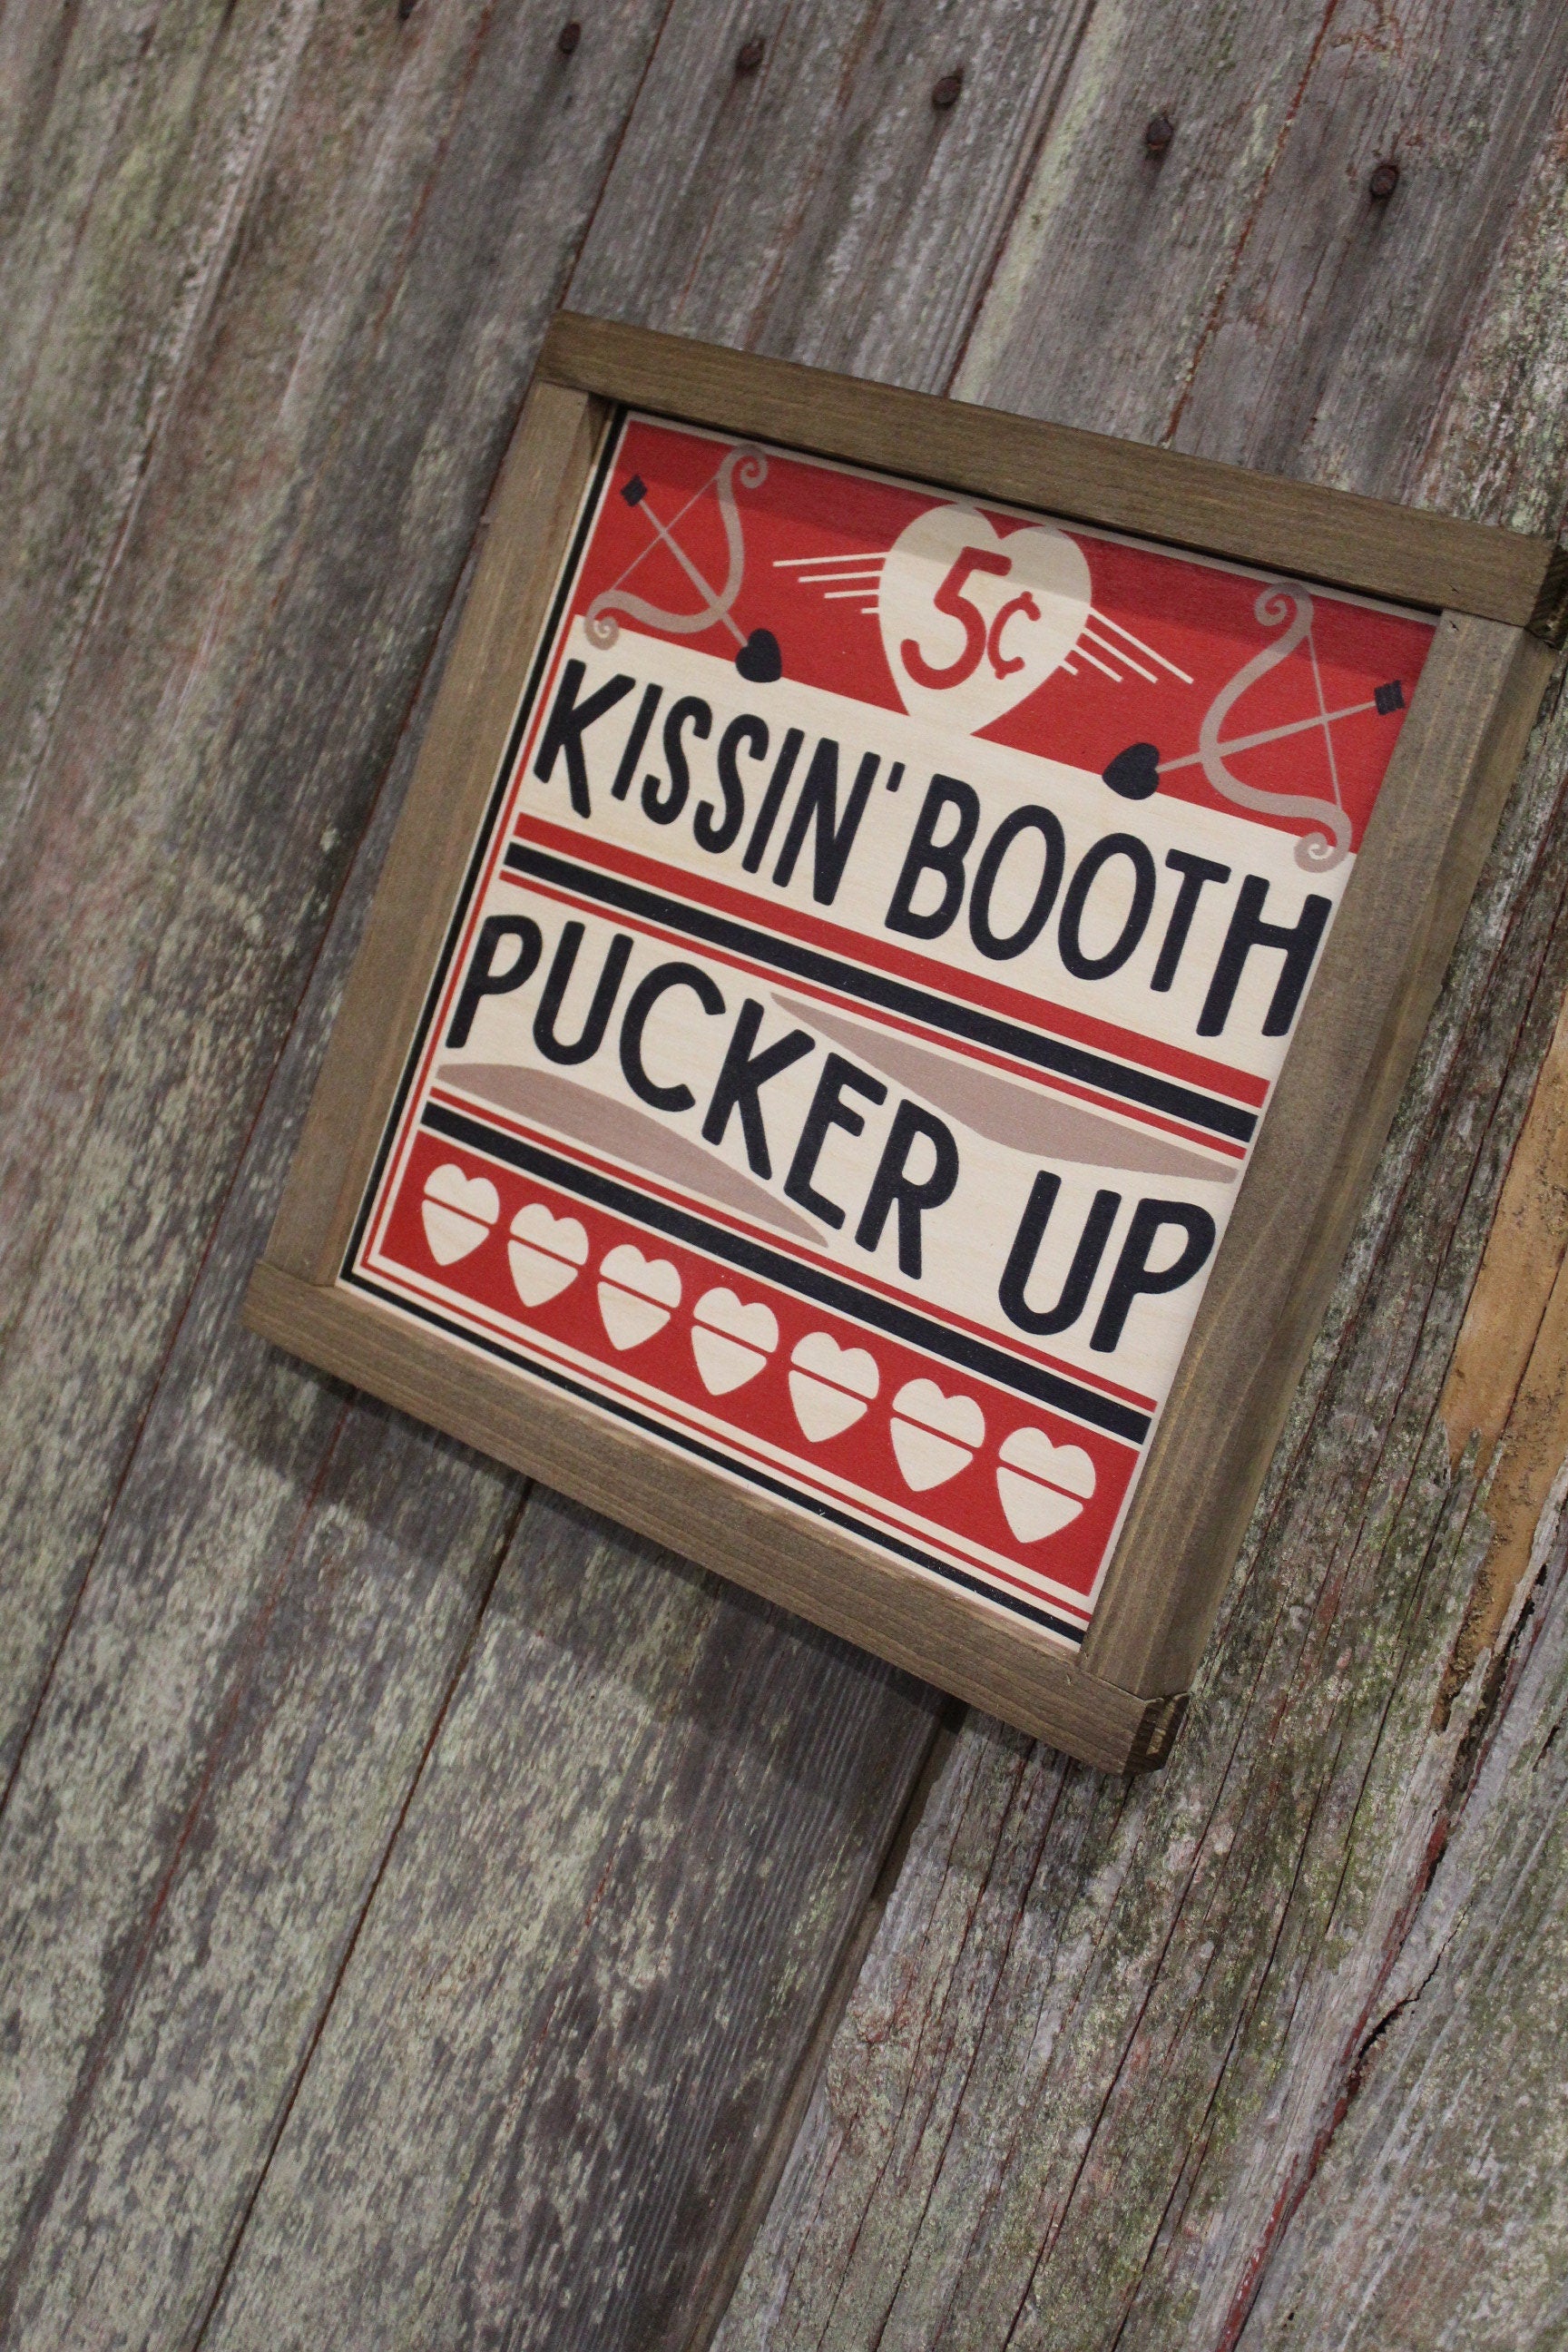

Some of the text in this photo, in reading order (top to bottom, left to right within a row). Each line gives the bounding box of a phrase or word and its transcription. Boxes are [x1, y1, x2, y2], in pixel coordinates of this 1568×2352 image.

[533, 658, 1332, 1036] KISSIN' BOOTH
[446, 914, 1216, 1353] PUCKER UP
